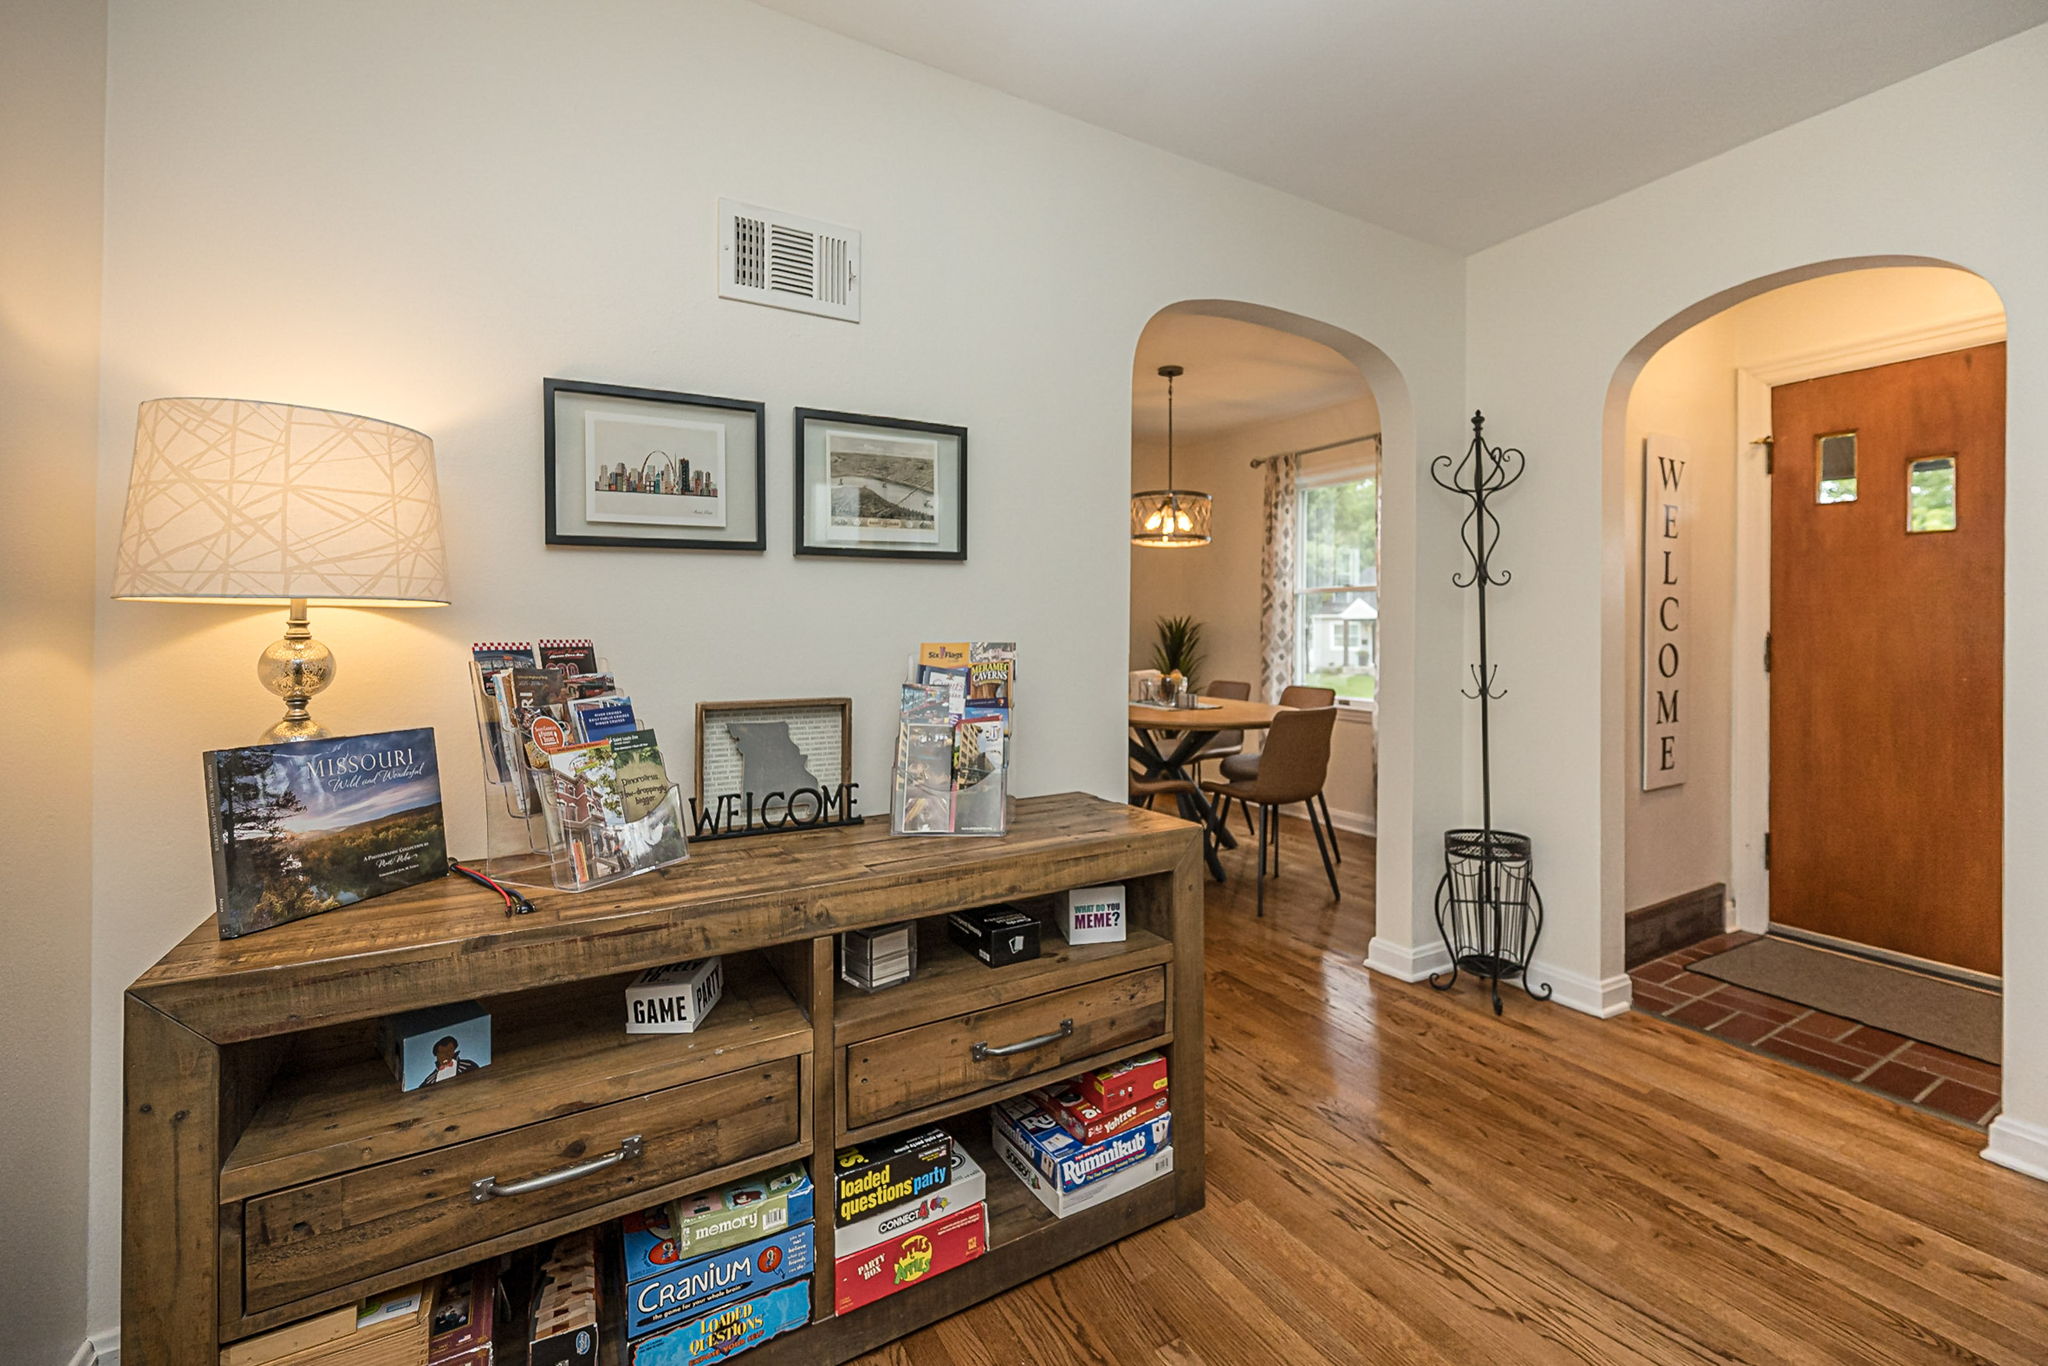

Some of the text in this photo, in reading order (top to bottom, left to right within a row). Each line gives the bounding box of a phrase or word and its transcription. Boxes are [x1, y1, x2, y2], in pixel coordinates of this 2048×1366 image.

[1656, 456, 1686, 772] WELCOME
[944, 650, 963, 659] Flags
[971, 663, 1009, 674] MERAMEC
[972, 671, 1008, 682] CAVERNS
[306, 748, 415, 779] MISSOURI
[328, 774, 361, 793] Wild
[377, 761, 425, 783] Wonderful
[688, 783, 862, 836] WELCOME
[1074, 902, 1120, 914] WHAT DO YOU
[1074, 911, 1121, 930] MEME?
[696, 964, 721, 1014] PARTY
[633, 996, 688, 1024] GAME
[1104, 1106, 1138, 1133] Yahtzee
[1061, 1132, 1147, 1185] Rummikub
[841, 1164, 890, 1200] loaded
[841, 1166, 946, 1221] questions party
[695, 1210, 758, 1240] memory
[878, 1209, 920, 1234] CONNECT
[857, 1253, 886, 1275] PARTY
[864, 1265, 882, 1280] BOX
[652, 1311, 663, 1320] the
[664, 1305, 681, 1318] game
[682, 1302, 691, 1311] for
[692, 1297, 706, 1308] your
[707, 1289, 725, 1301] whole
[700, 1303, 753, 1335] LOADED
[689, 1315, 764, 1356] QUESTIONS
